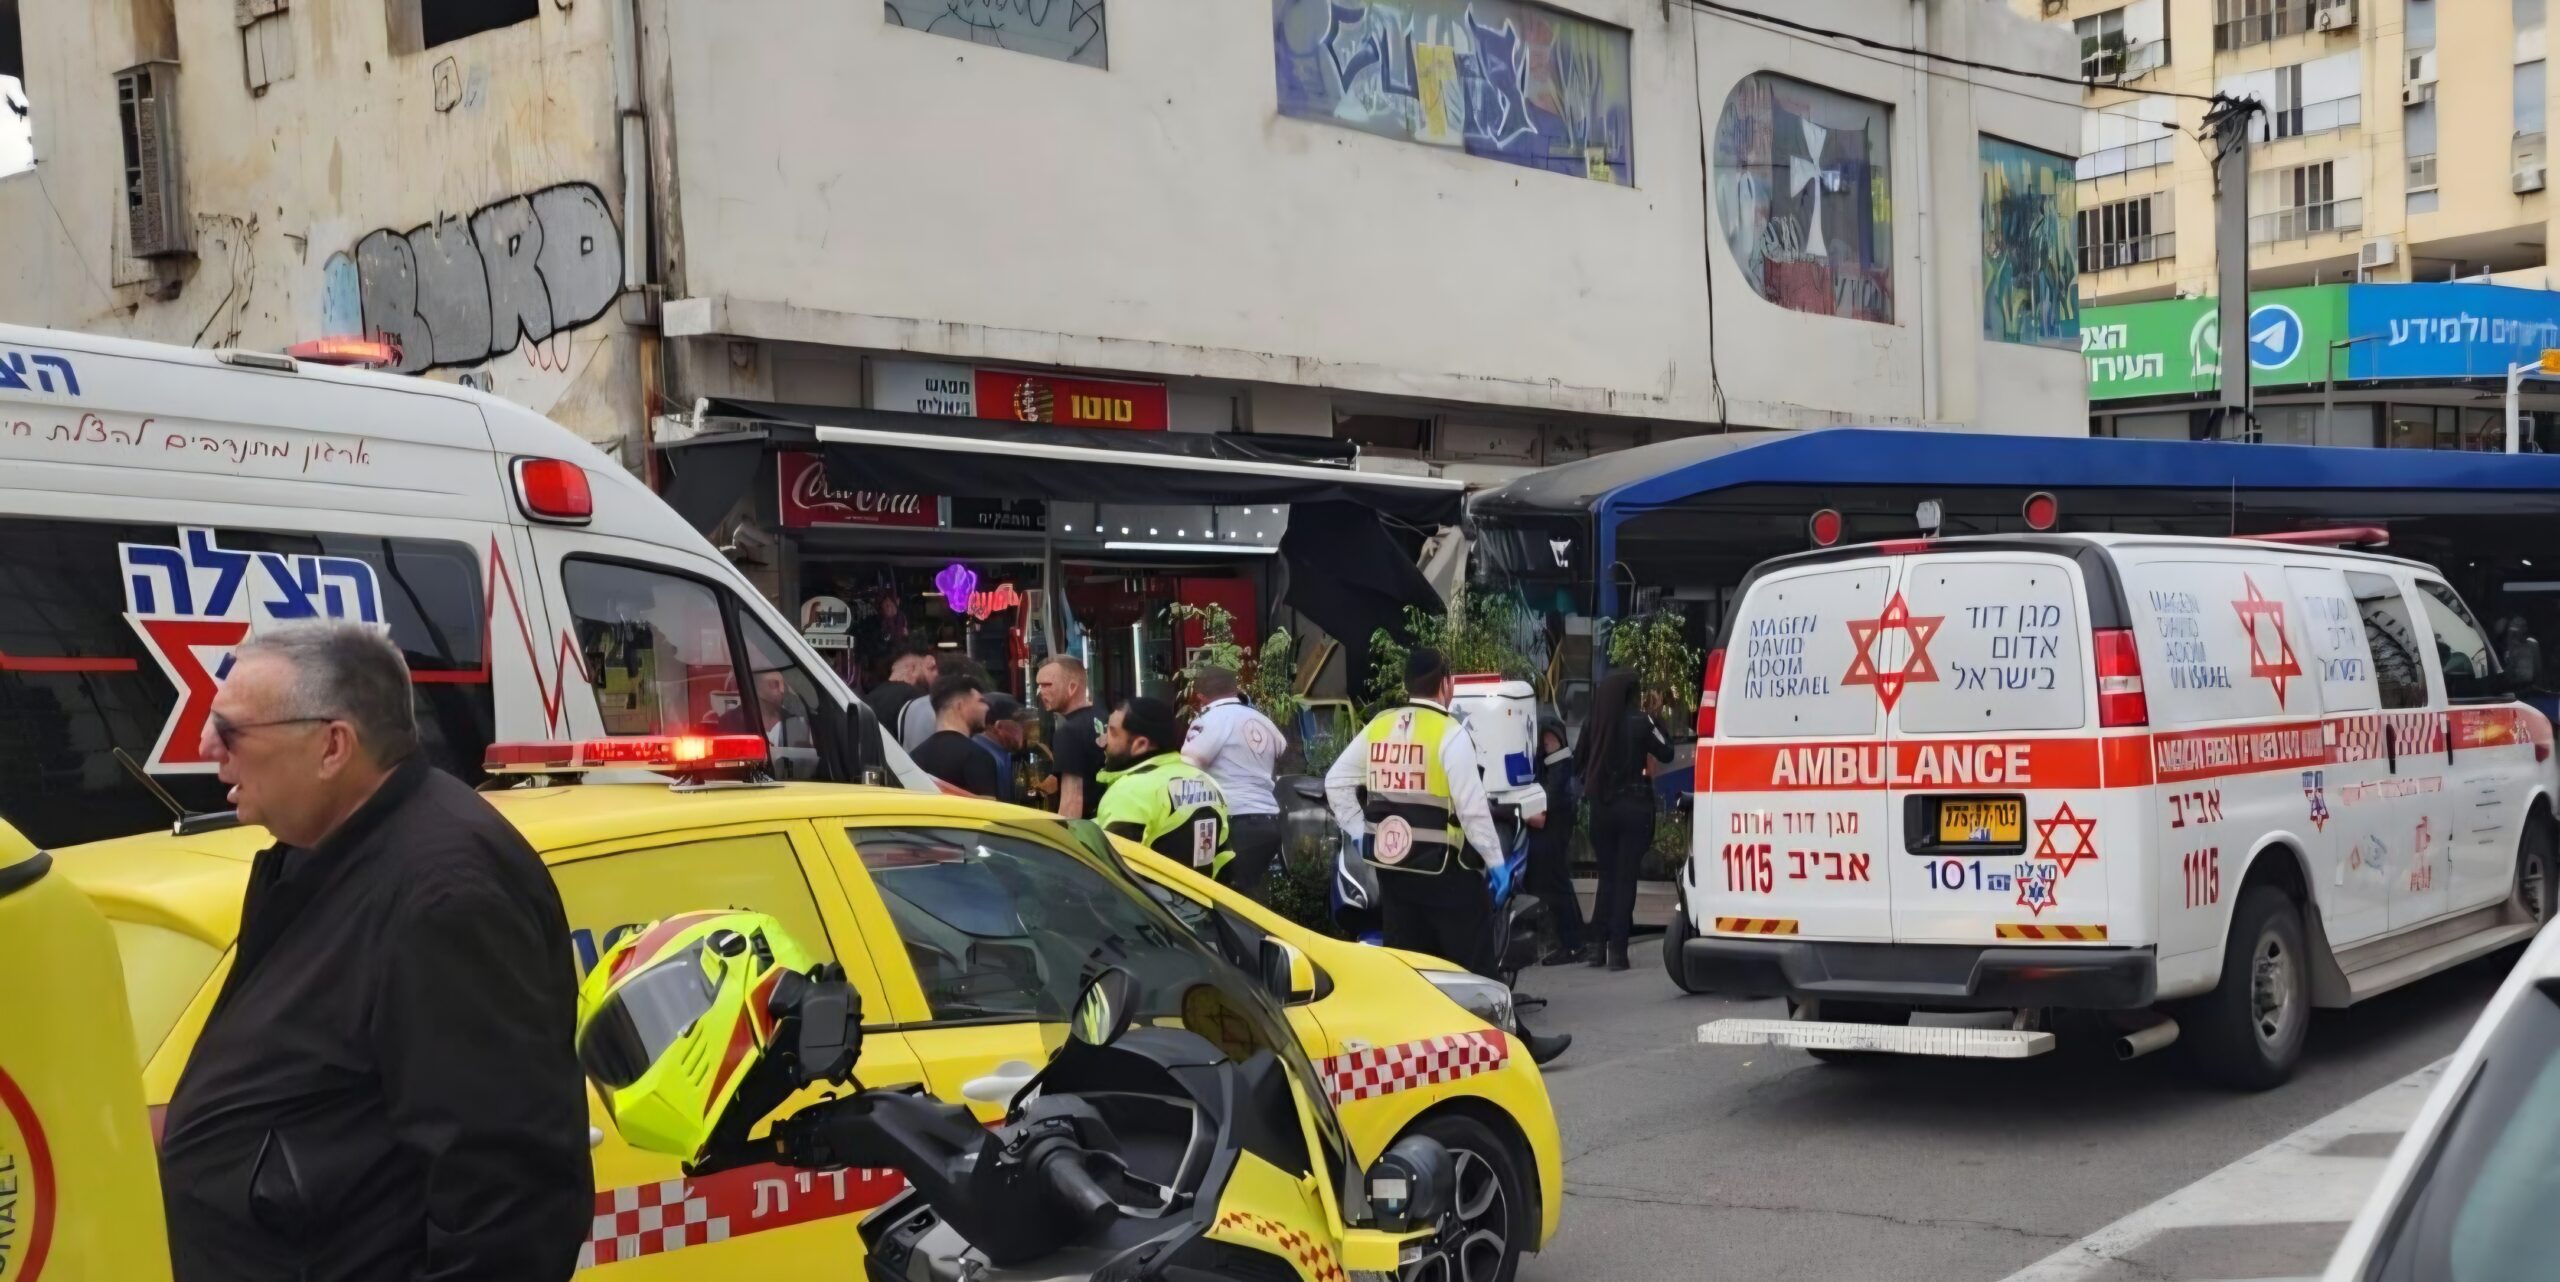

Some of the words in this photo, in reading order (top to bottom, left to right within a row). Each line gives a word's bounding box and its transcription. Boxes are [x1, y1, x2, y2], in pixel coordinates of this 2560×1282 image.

[1070, 394, 1132, 422] טוטו
[46, 412, 155, 446] להצלת
[165, 434, 289, 464] מתנדבים
[301, 437, 370, 474] ארגון
[127, 530, 379, 623] הצלה
[1750, 614, 1817, 637] MAGEN
[1965, 605, 2009, 629] דוד
[2018, 605, 2060, 633] מגן
[1748, 637, 1804, 658] DAVID
[1992, 635, 2058, 659] אדום
[1746, 656, 1803, 680] ADOM
[1951, 661, 2056, 691] בישראל
[1744, 678, 1763, 699] IN
[1769, 675, 1830, 698] ISRAEL
[1771, 744, 2032, 786] AMBULANCE
[2168, 788, 2223, 829] אביב
[1782, 812, 1815, 835] דוד
[1827, 811, 1858, 838] מגן
[1722, 843, 1773, 894] 1115
[1787, 850, 1870, 882] אביב
[1923, 860, 1982, 891] 101
